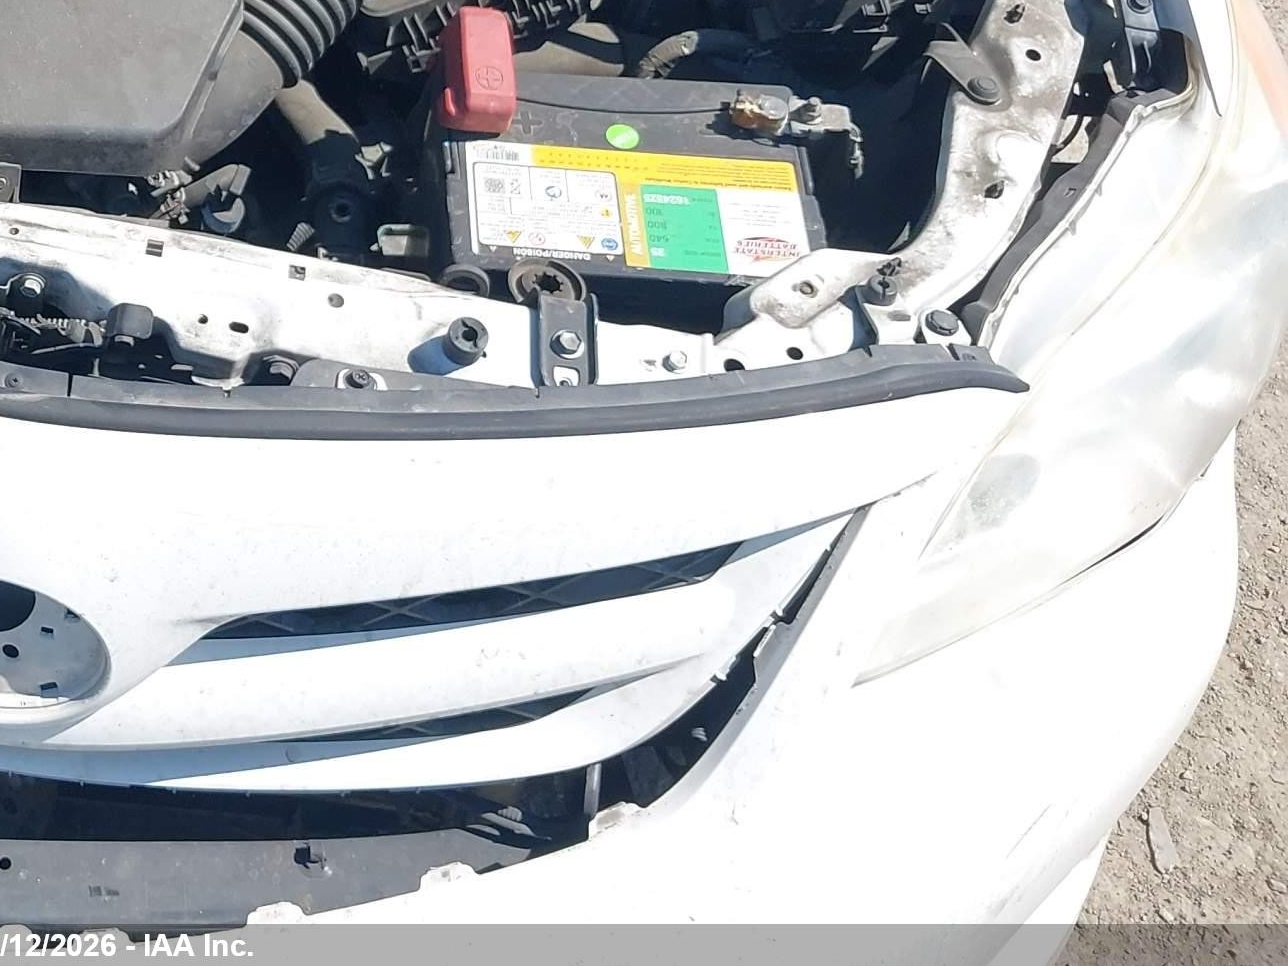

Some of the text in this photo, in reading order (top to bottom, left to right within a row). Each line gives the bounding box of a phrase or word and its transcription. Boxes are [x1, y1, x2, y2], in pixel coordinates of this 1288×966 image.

[626, 194, 643, 256] AUTOMOTIVE
[736, 240, 798, 250] BATTERIES
[512, 247, 592, 261] DANGER/POISON
[732, 247, 800, 257] INTERSTATE
